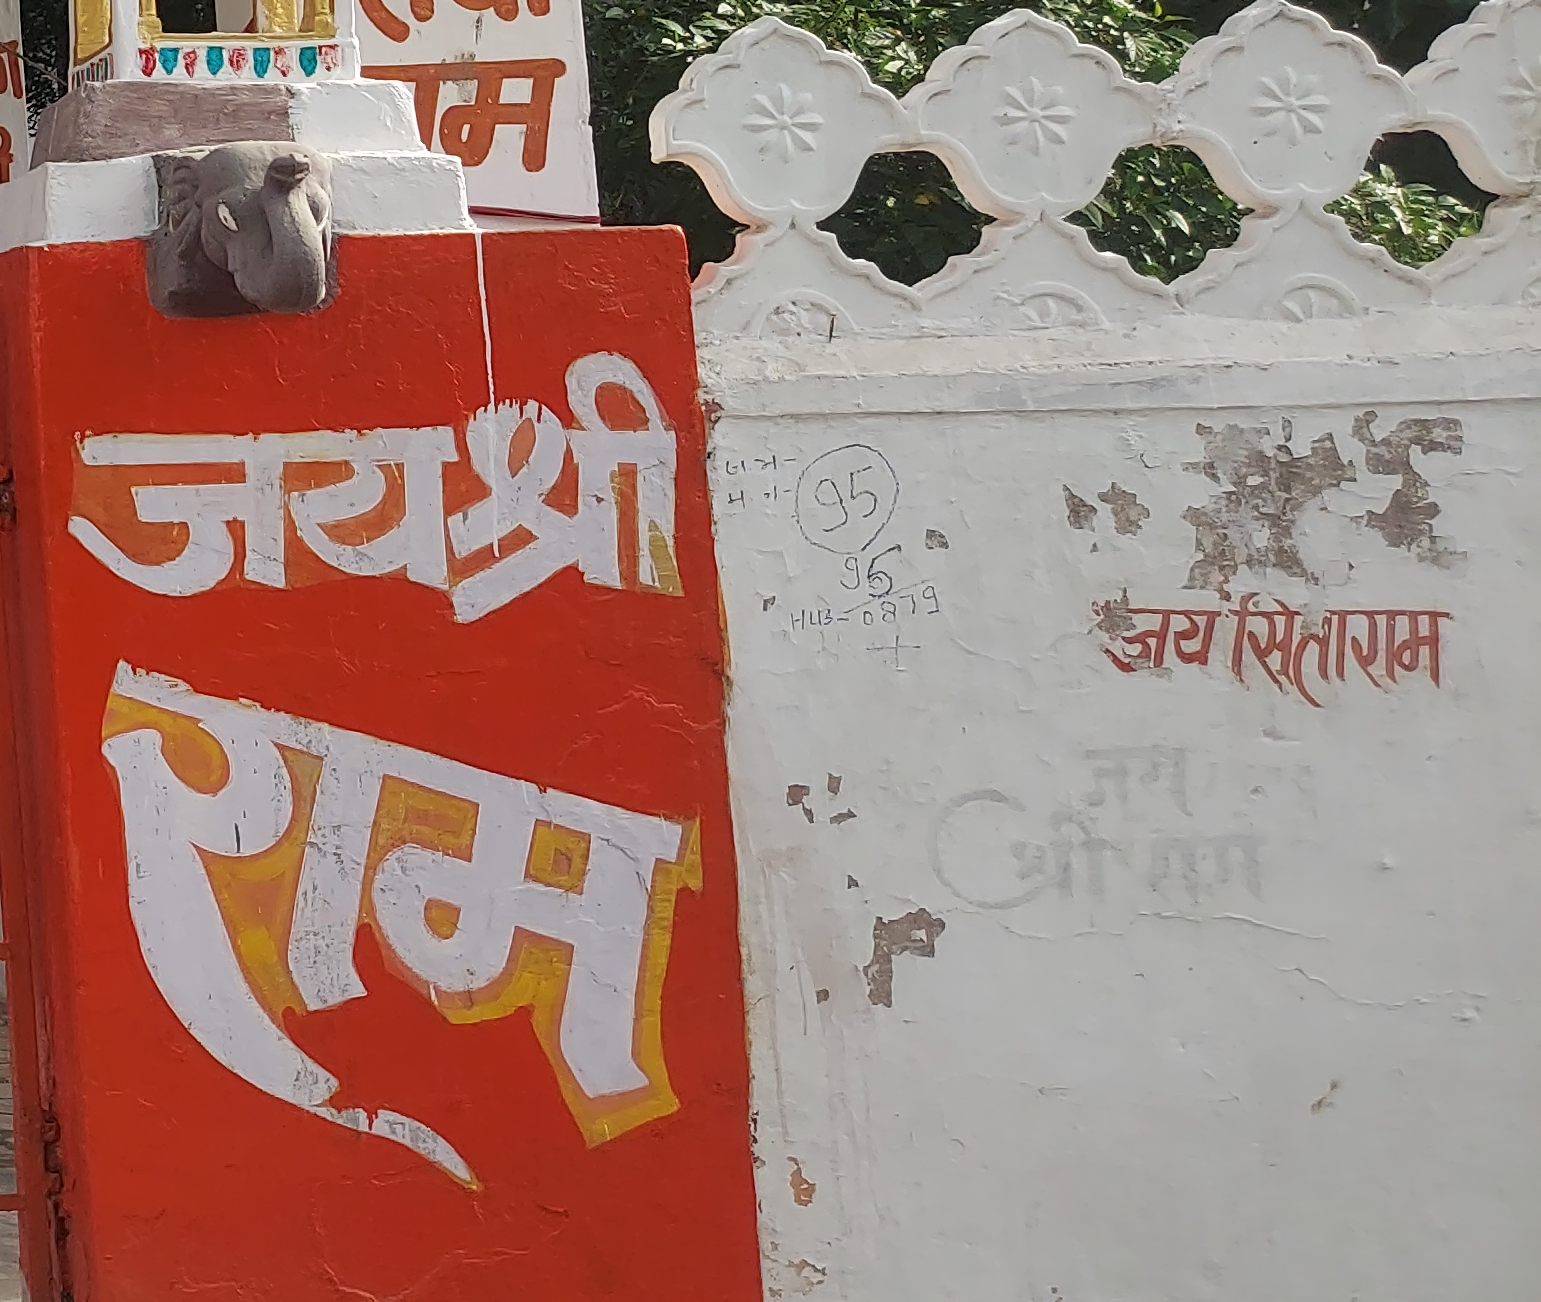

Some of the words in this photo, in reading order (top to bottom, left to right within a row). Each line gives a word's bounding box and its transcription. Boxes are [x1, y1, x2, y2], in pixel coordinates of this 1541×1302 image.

[67, 426, 458, 597] जय
[447, 351, 682, 624] श्री
[1101, 606, 1222, 674] जय
[101, 658, 695, 1192] राम
